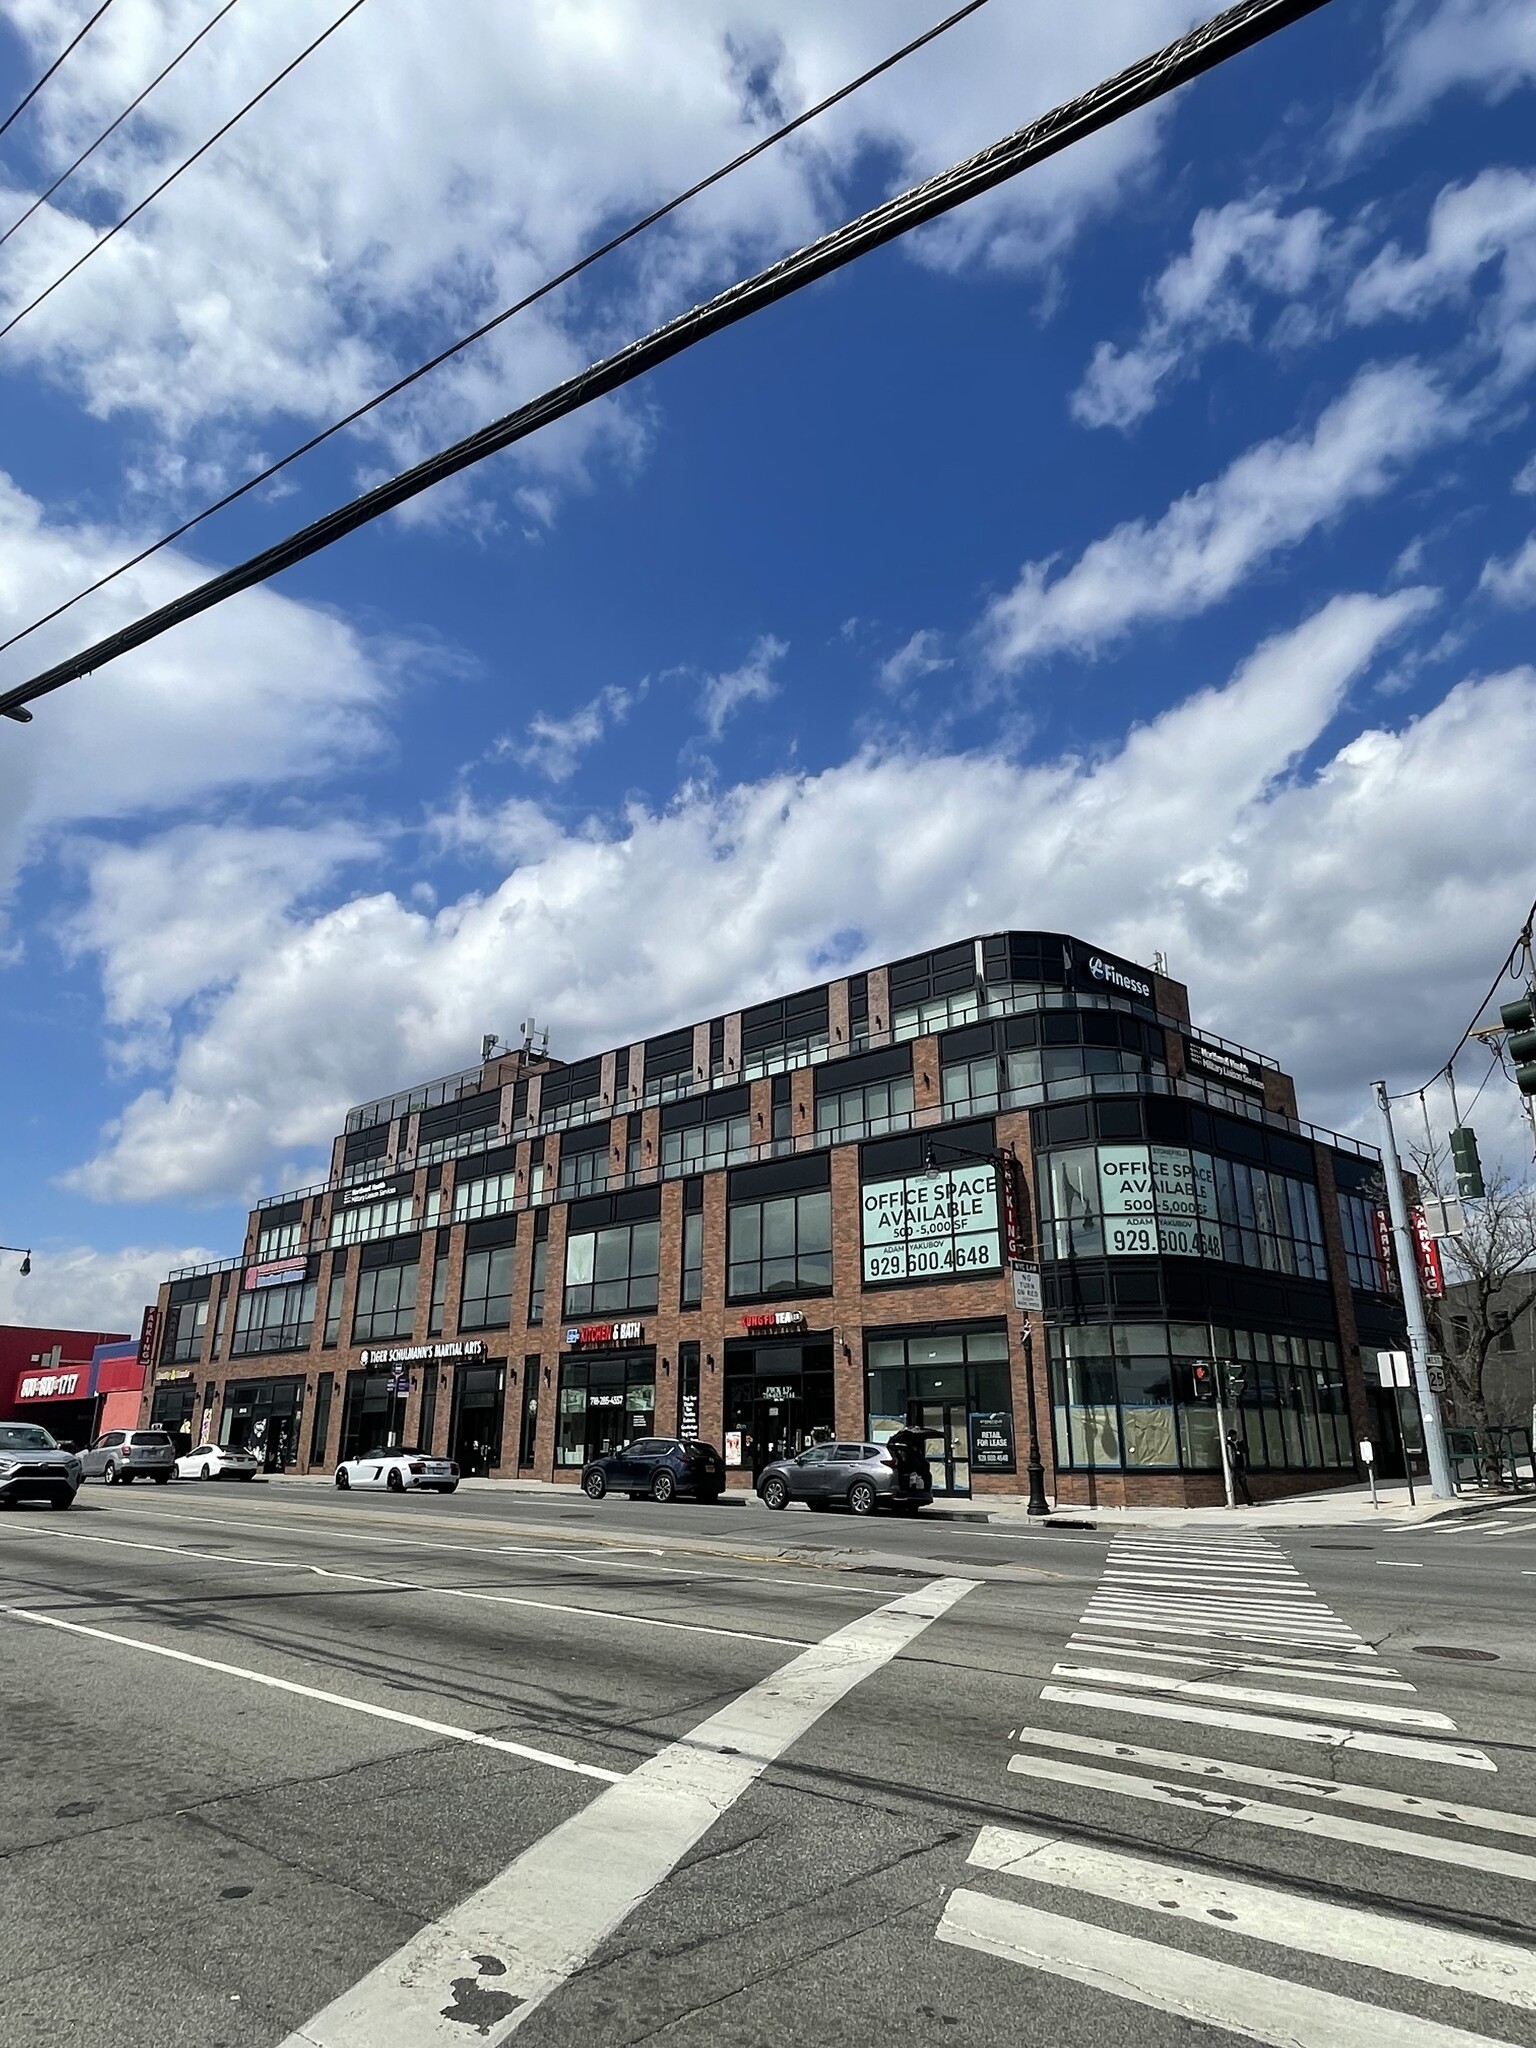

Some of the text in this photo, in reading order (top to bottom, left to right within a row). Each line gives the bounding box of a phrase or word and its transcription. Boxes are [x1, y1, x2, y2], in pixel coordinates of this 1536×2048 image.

[1104, 963, 1150, 997] Finesse
[1103, 1161, 1213, 1183] OFFICE SPACE
[864, 1176, 997, 1211] OFFICE SPACE
[1120, 1180, 1207, 1199] AVAILABLE
[878, 1198, 983, 1228] AVAILABLE
[1124, 1200, 1153, 1211] 500
[893, 1226, 913, 1238] 500
[954, 1219, 968, 1230] SF
[1159, 1219, 1193, 1228] YAKUBOV
[883, 1240, 944, 1254] ADAM YAKUBOV
[1113, 1230, 1220, 1256] 929.600.4648
[1415, 1205, 1438, 1289] PARKING
[870, 1245, 989, 1276] 929.600.4648
[1021, 1274, 1032, 1282] NO
[1027, 1290, 1039, 1298] RED
[741, 1315, 763, 1328] KUNG
[764, 1313, 775, 1325] FU
[775, 1312, 792, 1325] TEA
[142, 1308, 156, 1359] PARKING
[580, 1324, 612, 1343] KITCHEN
[612, 1323, 619, 1340] &
[620, 1322, 641, 1340] BATH
[370, 1350, 388, 1363] TIGER
[434, 1342, 462, 1357] MARTIAL
[464, 1340, 482, 1354] ARTS
[1430, 1372, 1444, 1386] 25
[977, 1439, 1008, 1447] FOR LEASE
[981, 1431, 1002, 1439] RETAIL
